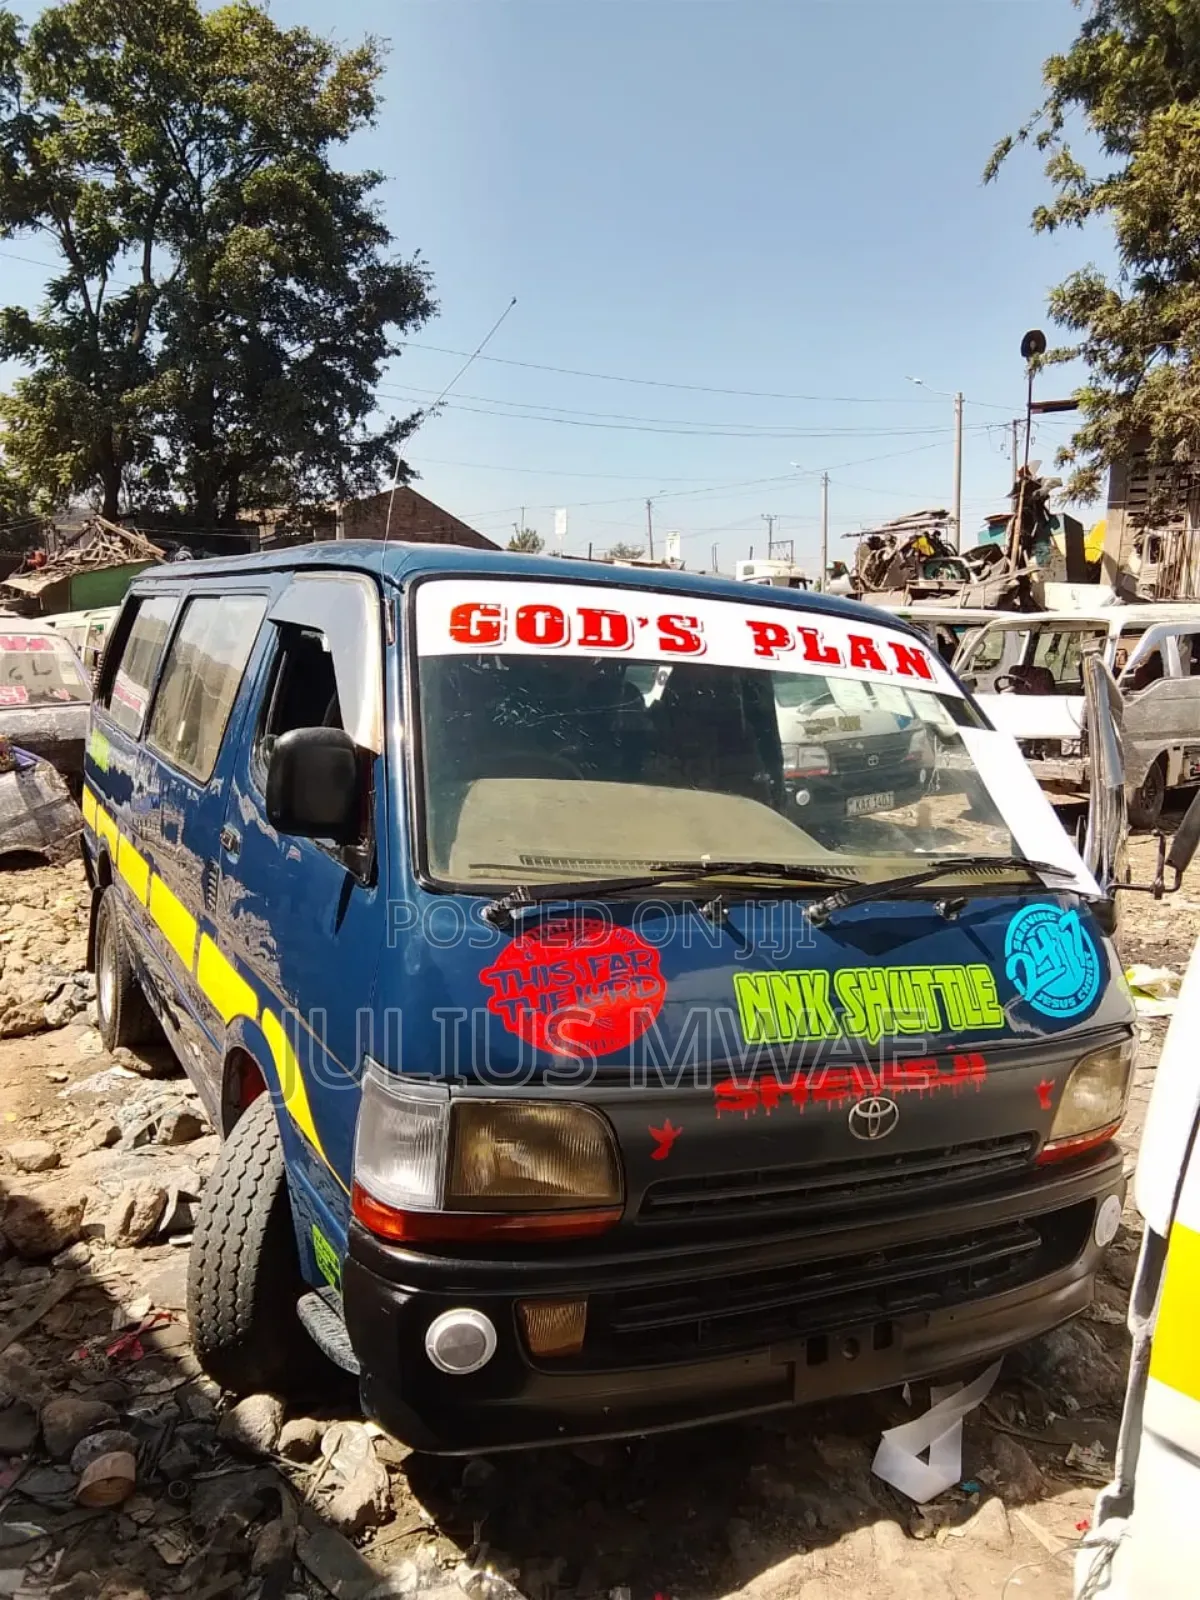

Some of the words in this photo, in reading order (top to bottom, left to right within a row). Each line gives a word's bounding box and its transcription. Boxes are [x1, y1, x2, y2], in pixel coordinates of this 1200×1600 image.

[449, 602, 706, 655] GOD'S
[746, 620, 937, 682] PLAN
[1013, 911, 1058, 952] SERVING
[487, 960, 576, 996] THIS
[587, 949, 654, 983] FAR
[495, 988, 574, 1025] THE
[733, 970, 839, 1044] NNK
[834, 964, 1005, 1045] SHUTTLE
[1035, 993, 1077, 1009] JESUS
